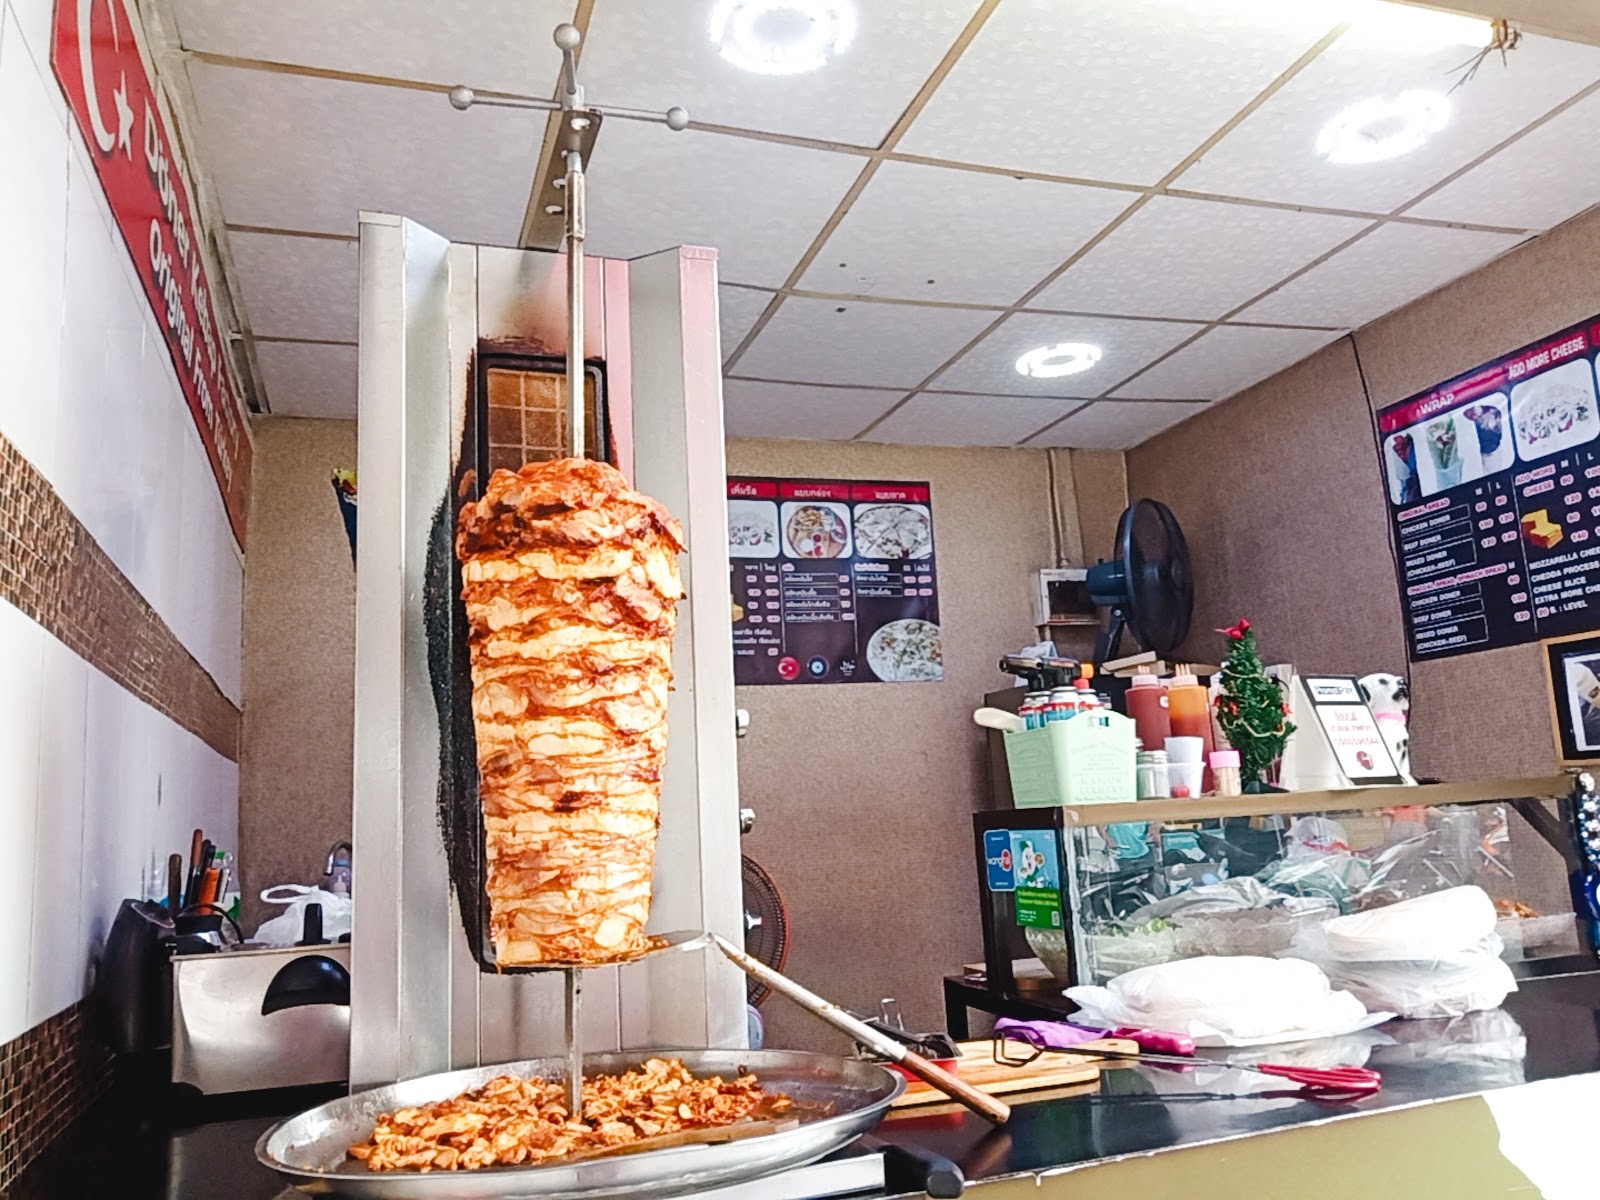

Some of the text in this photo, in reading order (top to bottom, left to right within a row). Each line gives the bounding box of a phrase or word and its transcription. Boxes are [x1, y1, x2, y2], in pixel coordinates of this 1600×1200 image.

[145, 96, 190, 268] Döner
[191, 250, 217, 379] Kebap
[150, 218, 194, 368] Original
[193, 347, 213, 430] From
[1507, 336, 1584, 380] ADD MORE CHEESE
[1419, 392, 1455, 415] WRAP
[1515, 464, 1556, 486] ADD MORE
[1523, 479, 1555, 497] CHEESE
[1401, 514, 1450, 534] CHICKEN DONER
[1419, 534, 1441, 546] DONER
[1426, 550, 1447, 561] DONER
[1529, 552, 1578, 570] MOZZARELLA
[1563, 560, 1600, 575] PROCESS
[1533, 576, 1587, 594] CHEESE SLICE
[1411, 590, 1460, 607] CHICKEN DONER
[1511, 592, 1527, 604] 100
[1535, 593, 1559, 605] EXTRA
[1560, 588, 1583, 599] MORE
[1563, 600, 1588, 611] LEVEL
[1430, 610, 1452, 621] DONER
[1514, 610, 1530, 622] 120
[1436, 625, 1459, 636] DONER
